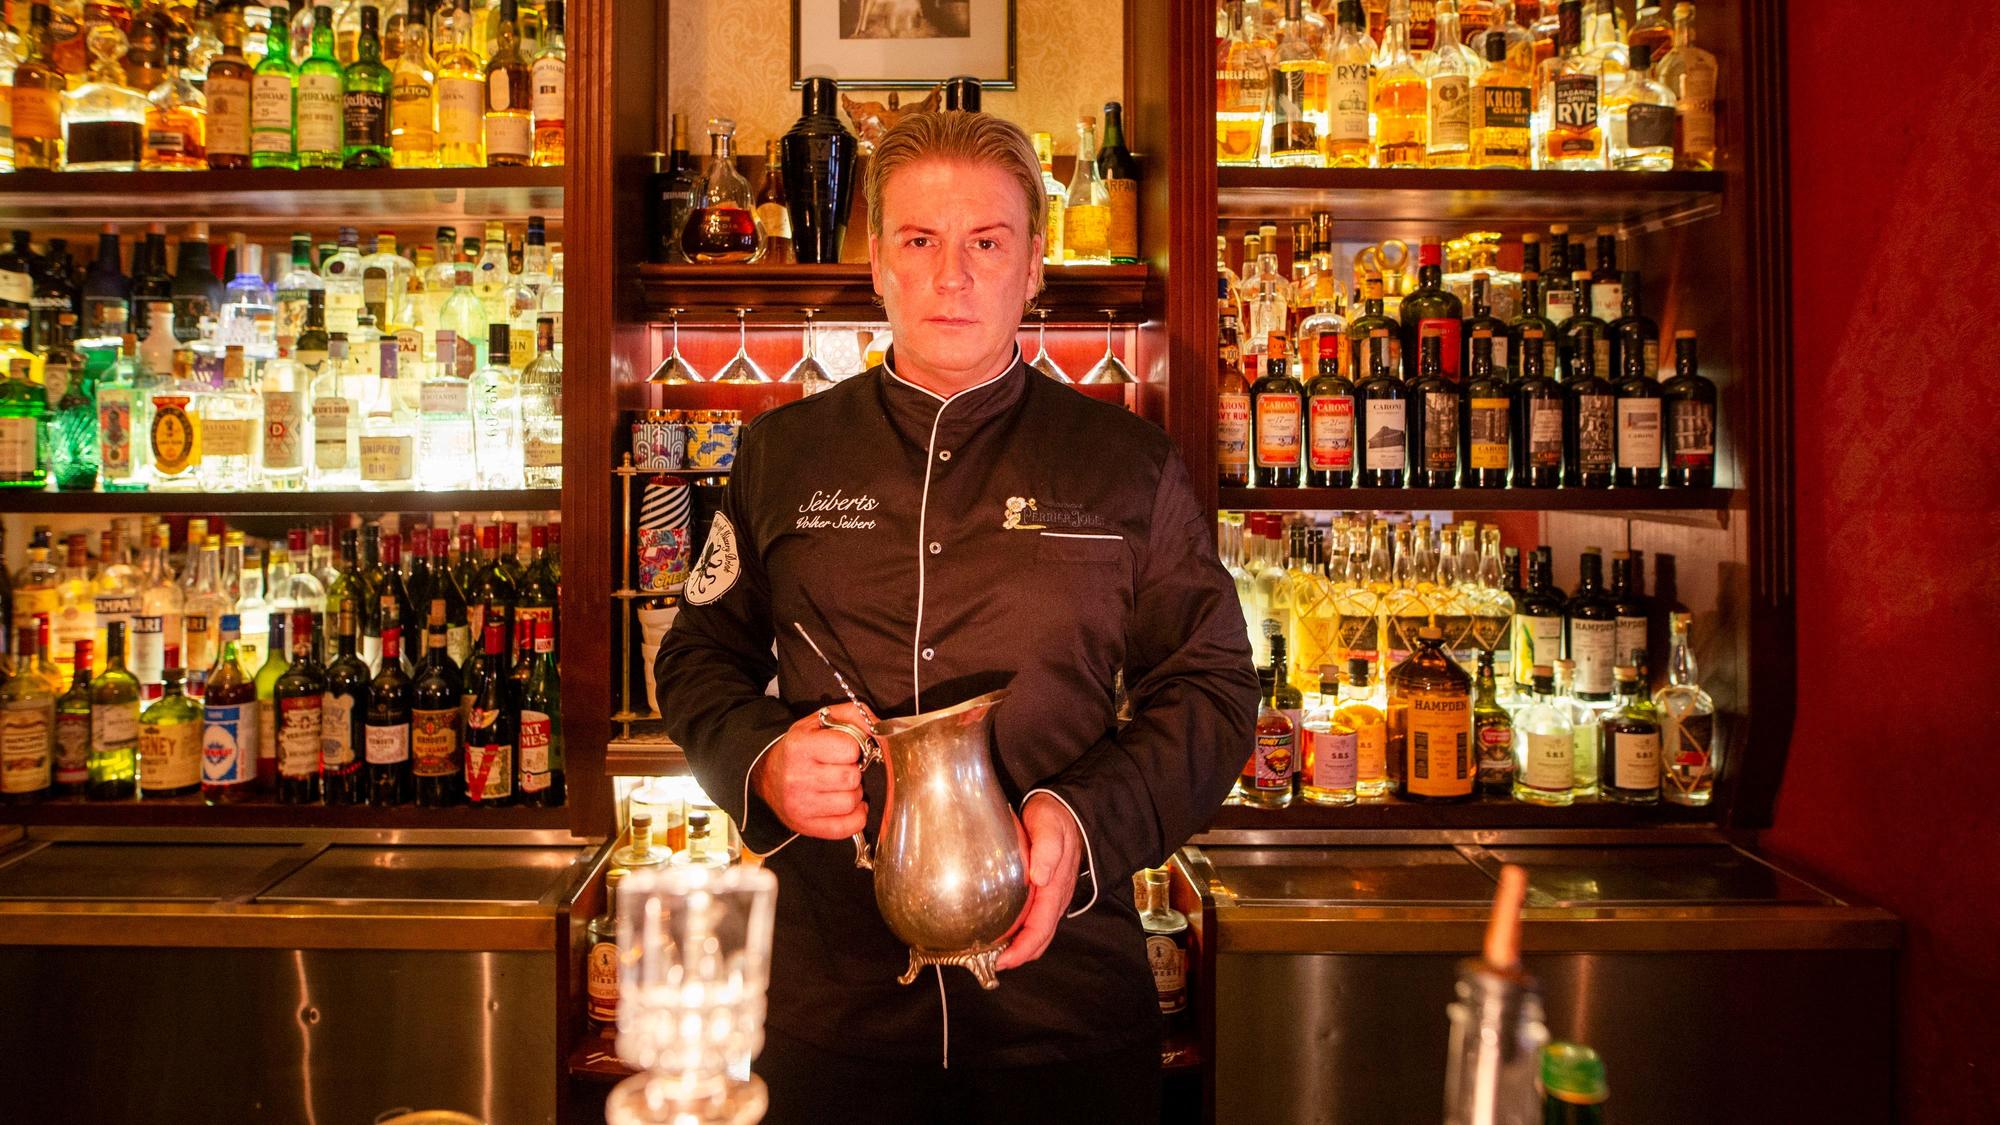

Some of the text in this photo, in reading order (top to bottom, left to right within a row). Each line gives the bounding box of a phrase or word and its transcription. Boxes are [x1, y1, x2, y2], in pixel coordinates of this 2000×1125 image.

[1486, 90, 1523, 107] KNOB
[1558, 103, 1597, 126] RYE
[1220, 402, 1246, 410] ARONI
[1263, 401, 1296, 410] CARONI
[1316, 403, 1349, 412] CARONI
[799, 489, 879, 513] Seiberts
[796, 514, 876, 530] Volker Seibert
[1415, 700, 1467, 712] HAMPDEN
